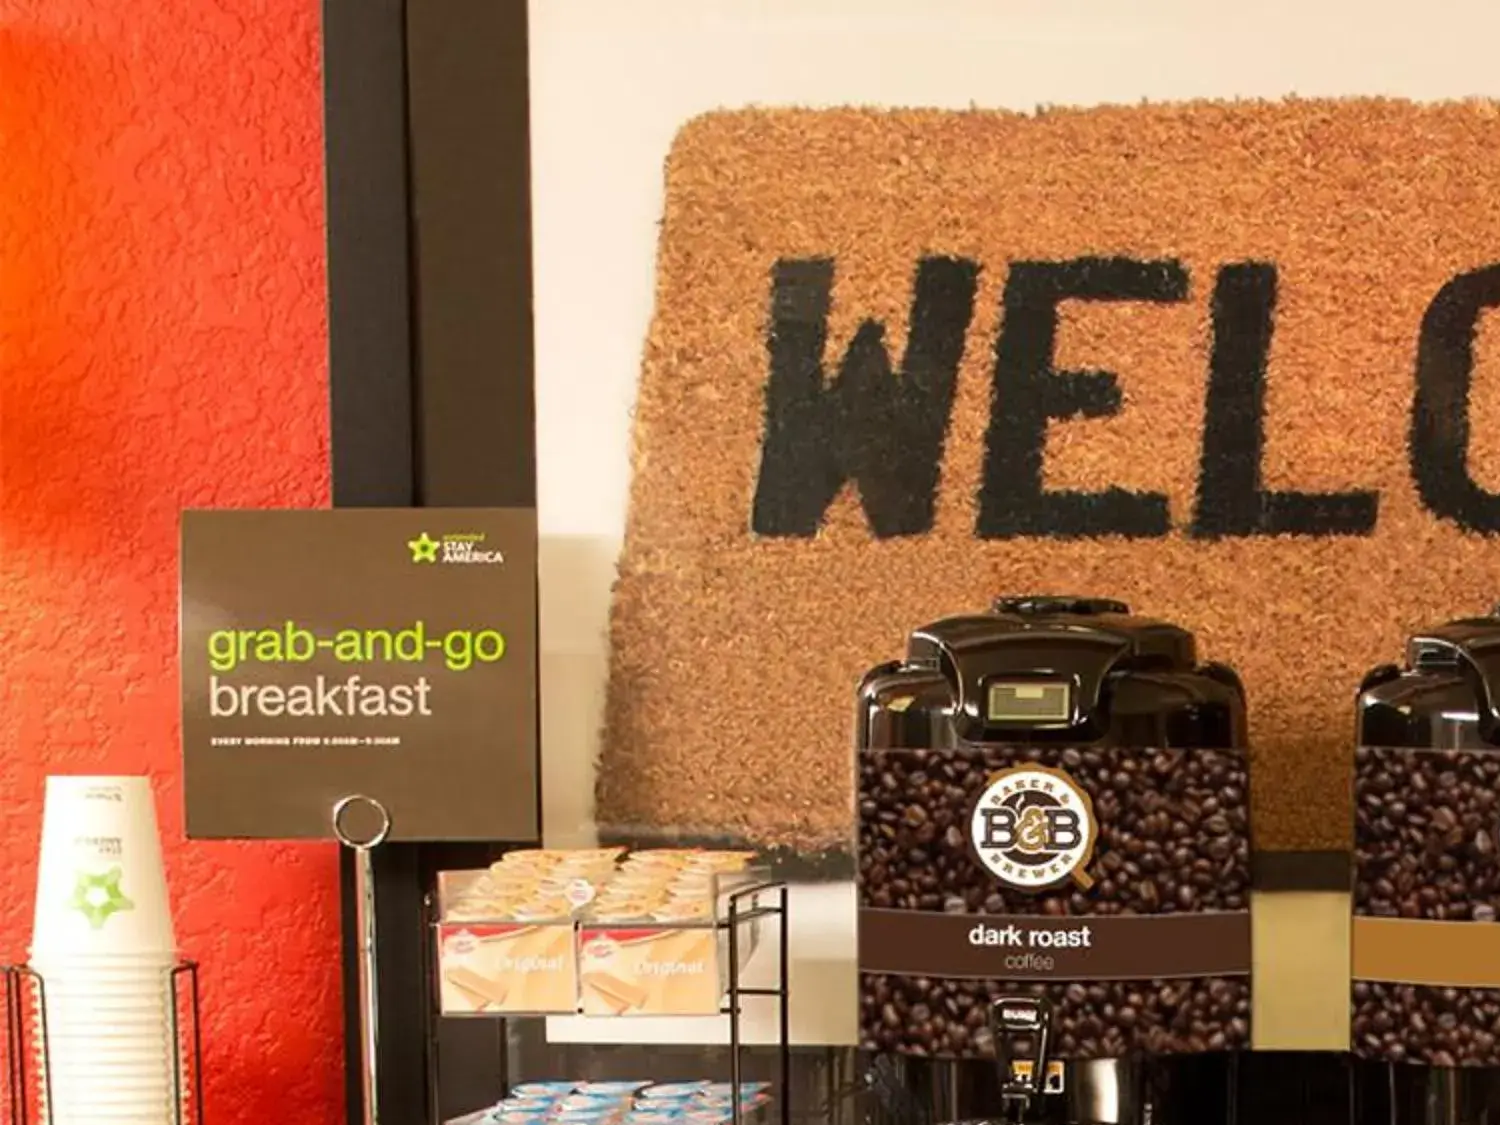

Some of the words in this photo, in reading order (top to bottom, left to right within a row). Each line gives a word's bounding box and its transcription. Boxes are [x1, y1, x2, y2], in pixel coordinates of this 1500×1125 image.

[208, 620, 505, 671] grab-and-go
[209, 674, 432, 717] breakfast
[980, 806, 1083, 851] B&B
[990, 852, 1073, 879] BREWER
[968, 922, 1023, 947] dark
[1028, 924, 1092, 948] roast
[1004, 952, 1056, 971] coffee
